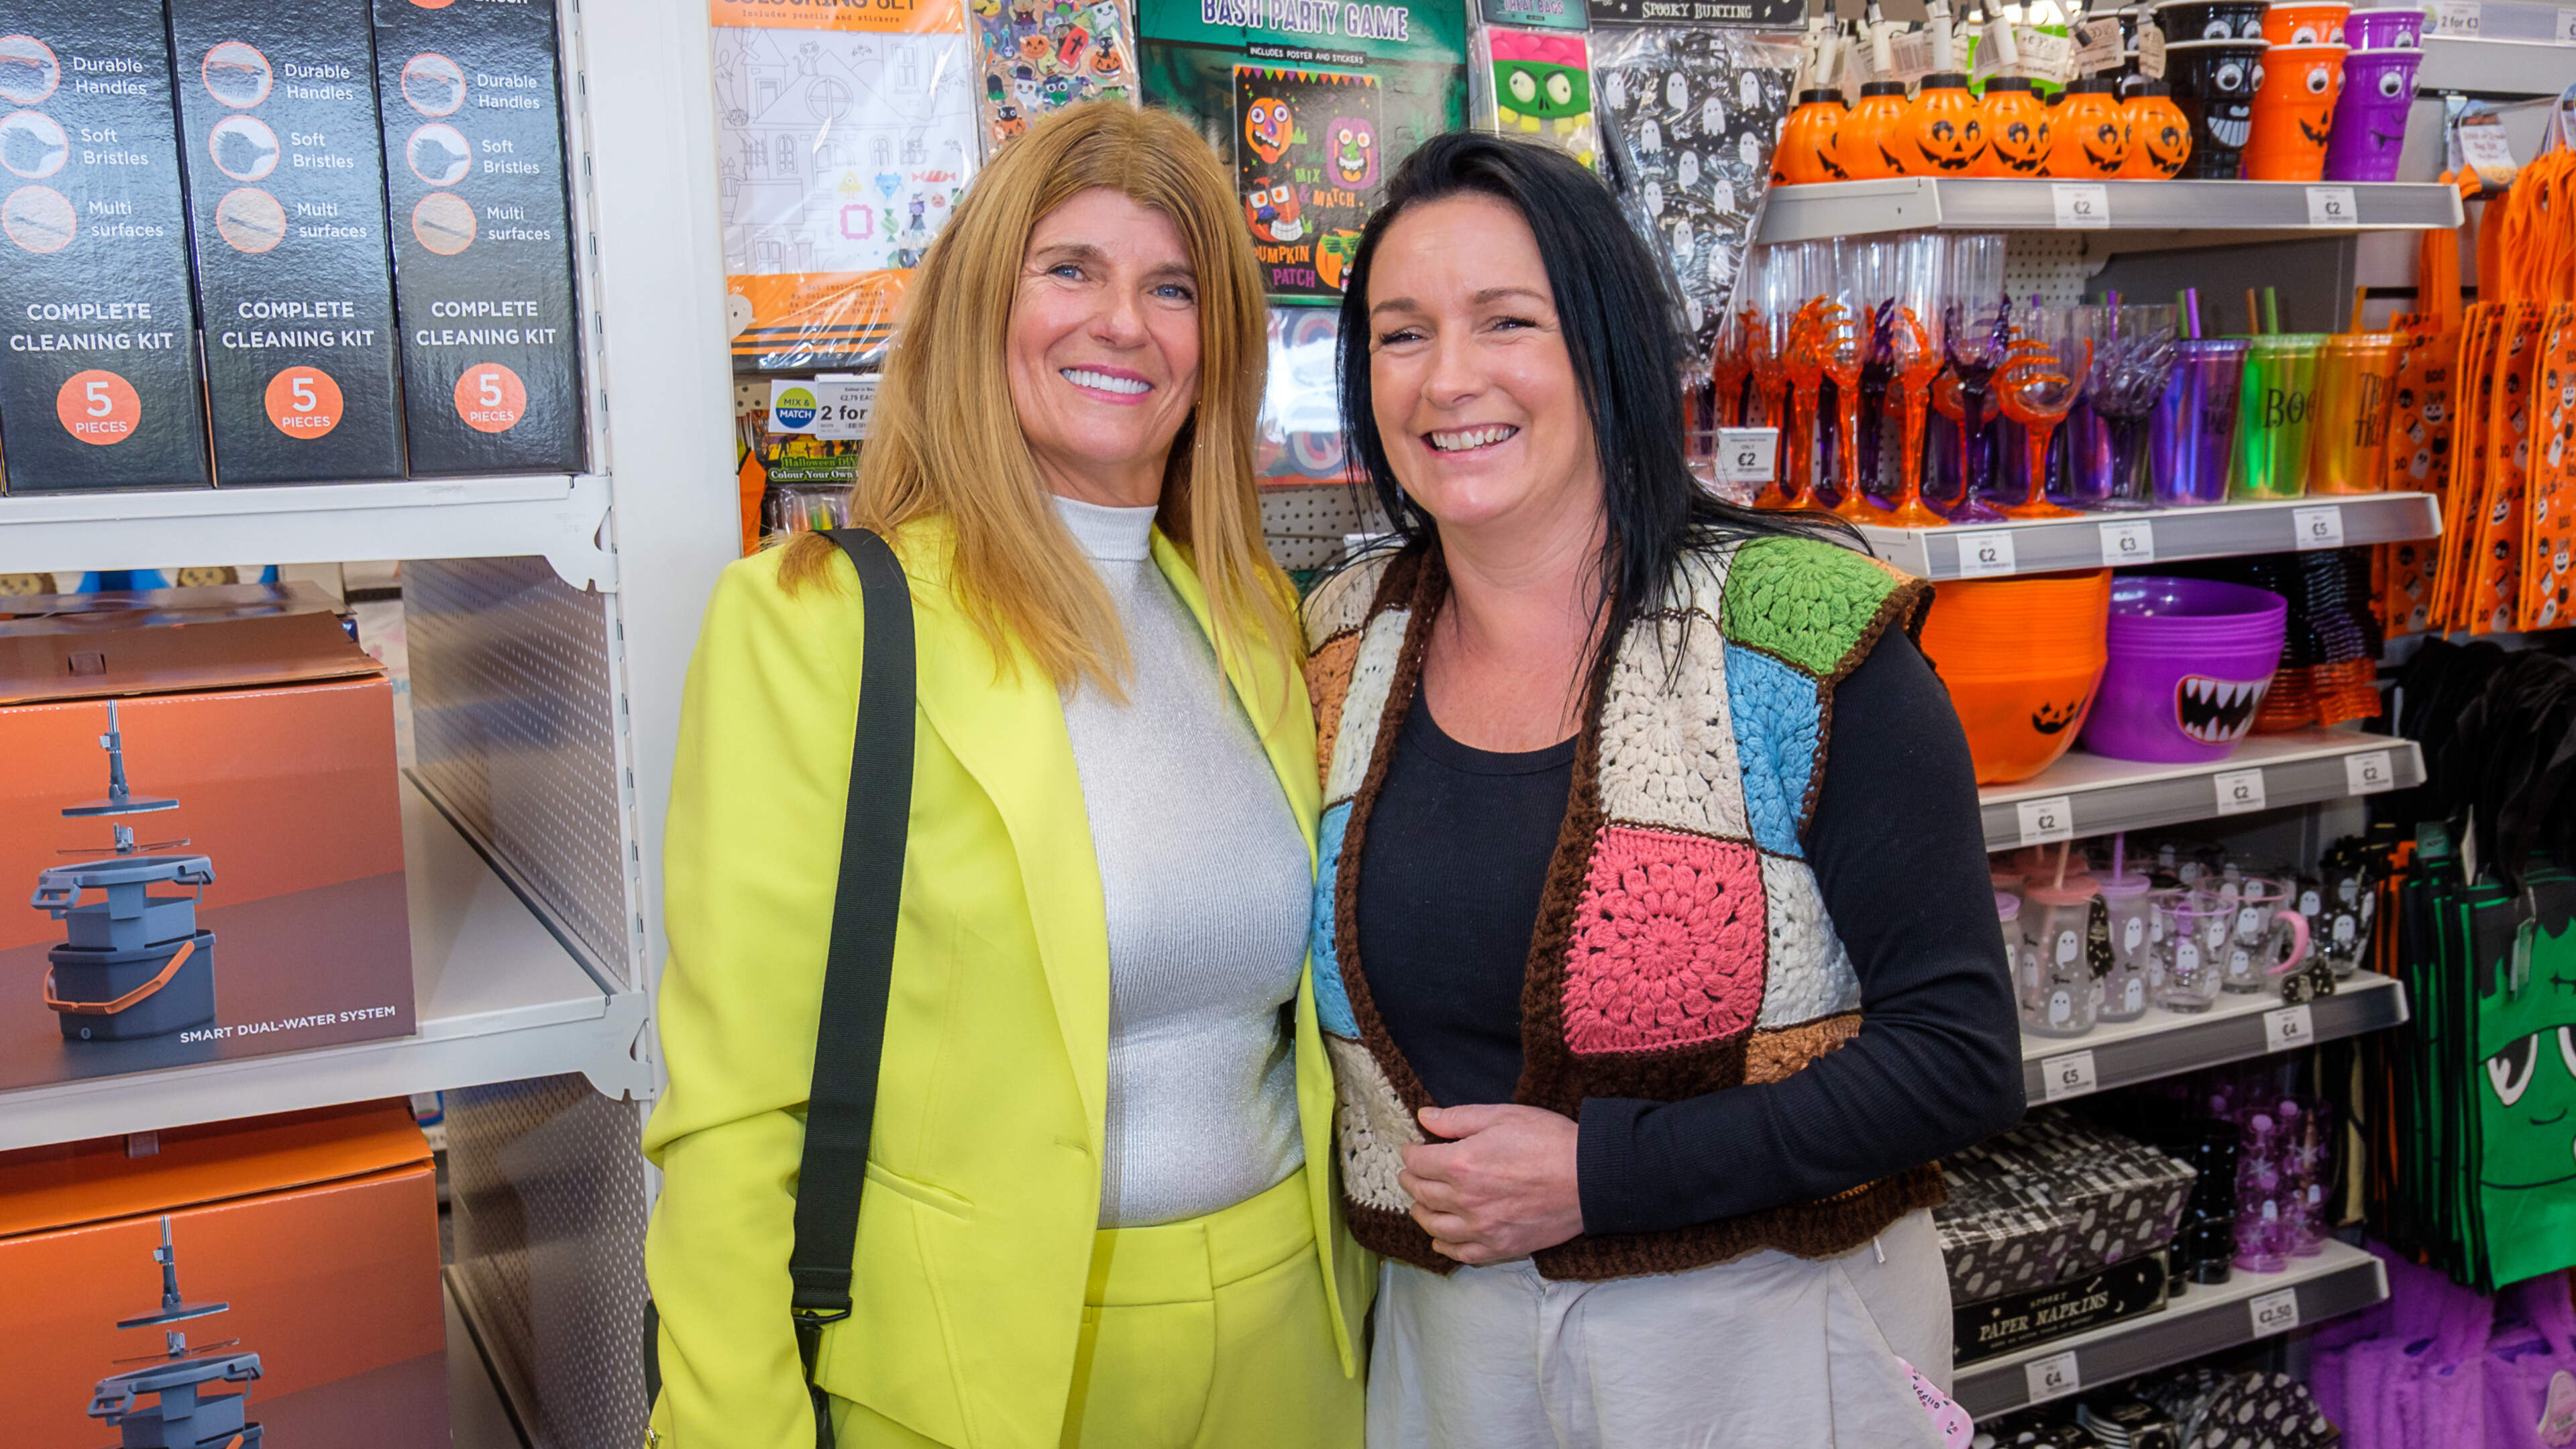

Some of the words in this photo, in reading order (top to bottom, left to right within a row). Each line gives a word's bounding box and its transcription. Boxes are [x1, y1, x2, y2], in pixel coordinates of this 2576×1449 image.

[742, 10, 786, 18] Includes
[1643, 2, 1690, 18] SPOOKY
[1694, 3, 1752, 19] BUNTING
[1203, 0, 1262, 28] BASH
[1269, 0, 1338, 35] PARTY
[1345, 4, 1409, 41] GAME
[2441, 16, 2448, 28] 2
[2450, 16, 2464, 28] for
[1250, 47, 1283, 58] INCLUDES
[1287, 50, 1313, 60] POSTER
[1316, 52, 1330, 62] AND
[1332, 54, 1364, 64] STICKERS
[73, 56, 143, 73] Durable
[284, 63, 351, 79] Durable
[75, 79, 148, 95] Handles
[477, 74, 537, 89] Durable
[286, 86, 354, 101] Handles
[479, 95, 541, 109] Handles
[80, 128, 118, 143] Soft
[291, 132, 326, 146] Soft
[482, 140, 514, 153] Soft
[83, 150, 150, 166] Bristles
[293, 154, 354, 168] Bristles
[484, 160, 541, 174] Bristles
[1294, 168, 1321, 184] MIX
[1313, 188, 1356, 209] MATCH
[89, 201, 132, 215] Multi
[297, 203, 338, 217] Multi
[487, 207, 525, 220] Multi
[2073, 201, 2092, 215] €2
[2325, 202, 2341, 215] €2
[91, 223, 164, 236] surfaces
[299, 224, 368, 238] surfaces
[488, 227, 551, 240] surfaces
[1272, 268, 1316, 288] PATCH
[27, 303, 152, 321] COMPLETE
[238, 301, 355, 319] COMPLETE
[431, 301, 539, 317] COMPLETE
[10, 333, 131, 352] CLEANING
[138, 332, 174, 350] KIT
[222, 331, 335, 349] CLEANING
[341, 330, 375, 347] KIT
[415, 329, 520, 346] CLEANING
[525, 328, 557, 345] KIT
[292, 377, 317, 413] 5
[479, 374, 502, 407] 5
[87, 381, 113, 417] 5
[784, 398, 801, 407] MIX
[470, 411, 515, 422] PIECES
[779, 410, 812, 419] MATCH
[820, 405, 833, 421] 2
[839, 405, 868, 421] for
[75, 421, 128, 434] PIECES
[282, 416, 331, 428] PIECES
[783, 457, 836, 468] Halloween
[1738, 452, 1756, 467] €2
[771, 470, 804, 479] Colour
[805, 470, 829, 479] Your
[831, 471, 853, 479] Own
[2312, 522, 2328, 537] €5
[2120, 537, 2137, 551] €3
[1978, 548, 1996, 562] €2
[2363, 767, 2377, 781] €2
[2233, 786, 2249, 800] €2
[2038, 815, 2055, 830] €2
[180, 1026, 233, 1044] SMART
[237, 1013, 336, 1036] DUAL-WATER
[340, 1006, 396, 1024] SYSTEM
[2282, 1022, 2298, 1037] €4
[2062, 1069, 2080, 1085] €5
[1978, 1315, 2029, 1341] PAPER
[2035, 1290, 2108, 1326] NAPKINS
[2259, 1303, 2292, 1324] €2.50
[2045, 1371, 2062, 1387] €4
